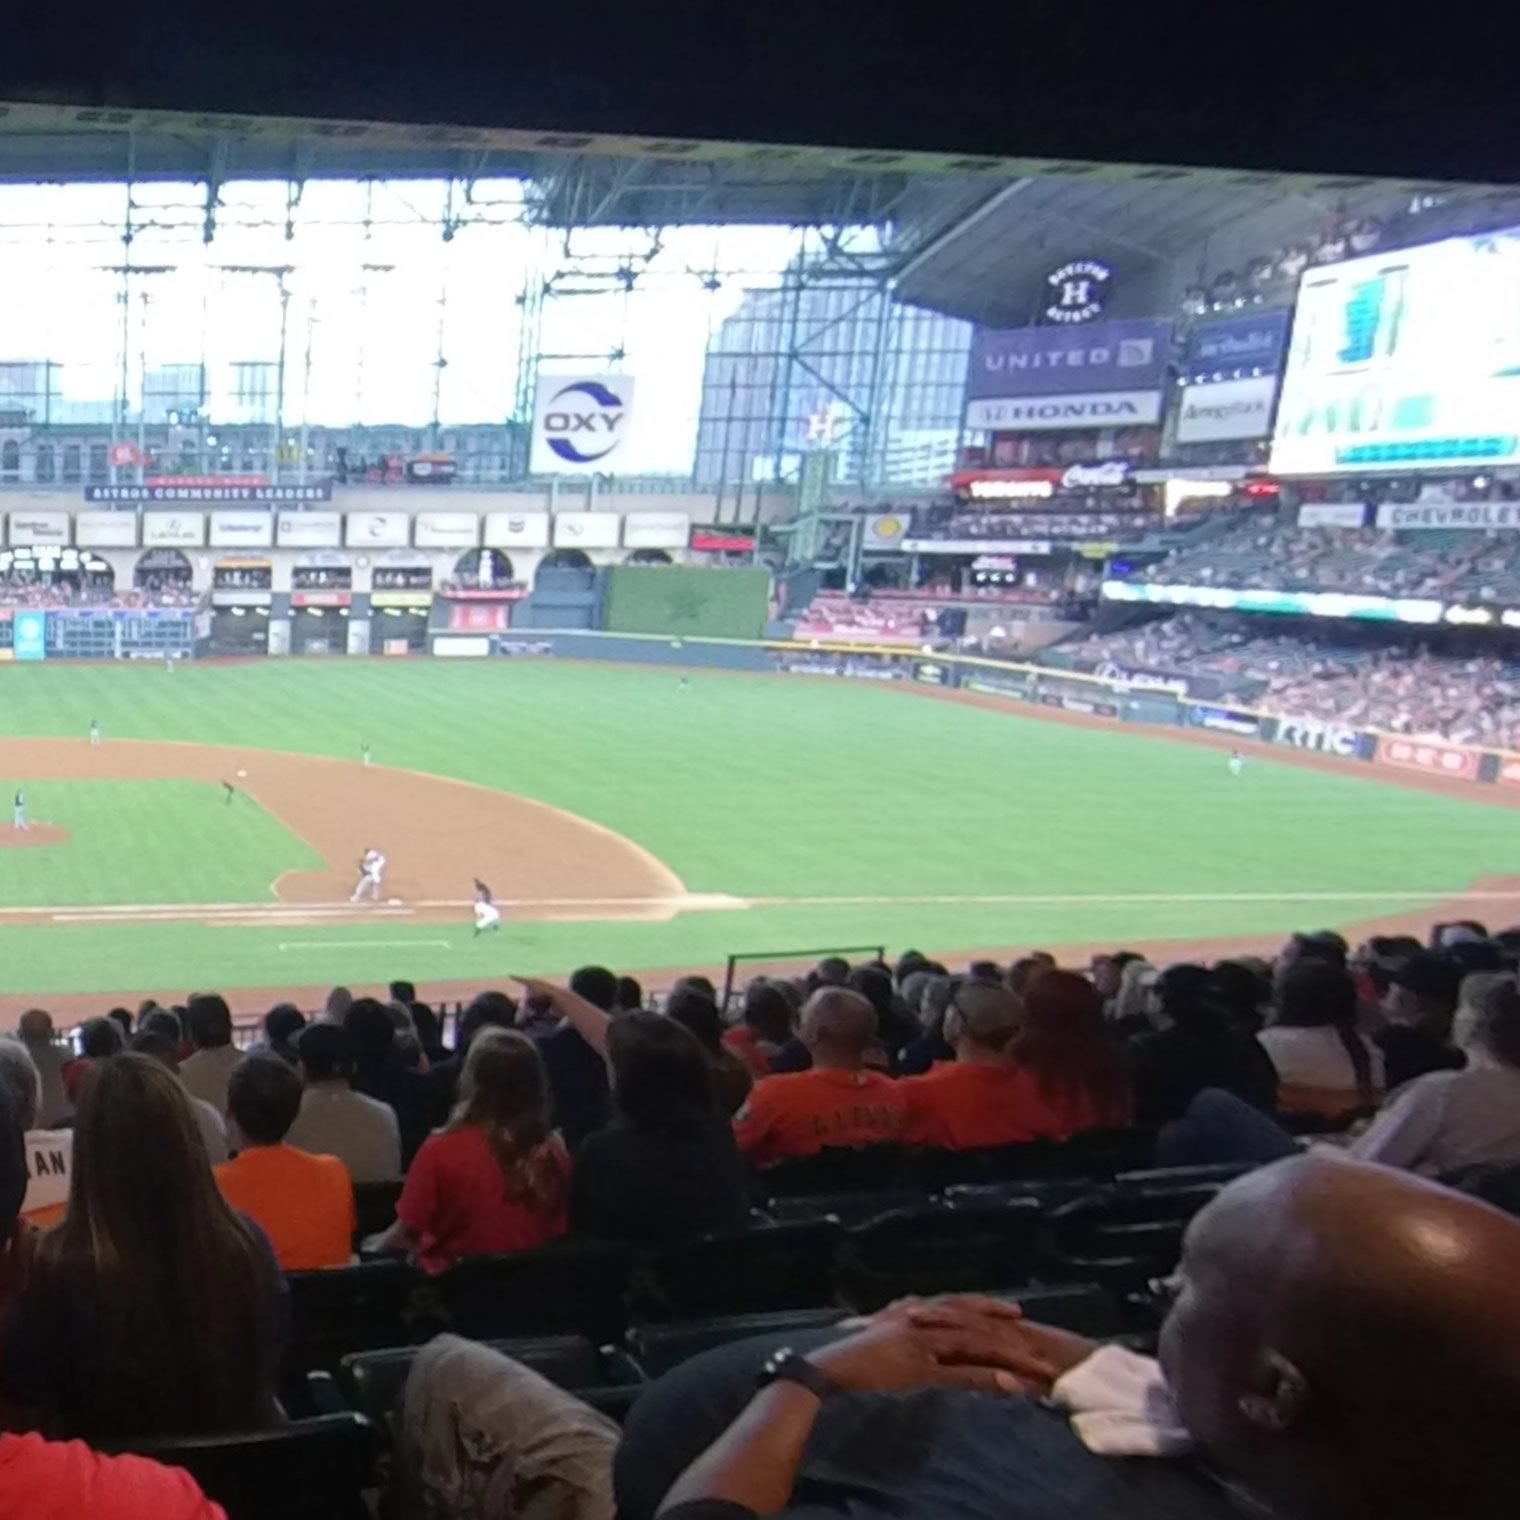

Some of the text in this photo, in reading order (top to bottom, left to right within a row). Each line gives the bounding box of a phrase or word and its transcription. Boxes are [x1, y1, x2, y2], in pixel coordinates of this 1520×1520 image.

[985, 347, 1110, 371] UNITED
[543, 411, 624, 433] OXY
[1013, 400, 1138, 422] HONDA
[93, 487, 323, 499] ASTROS COMMUNITY LEADERS
[1391, 507, 1520, 524] CHEVROLE
[27, 1150, 66, 1179] AN
